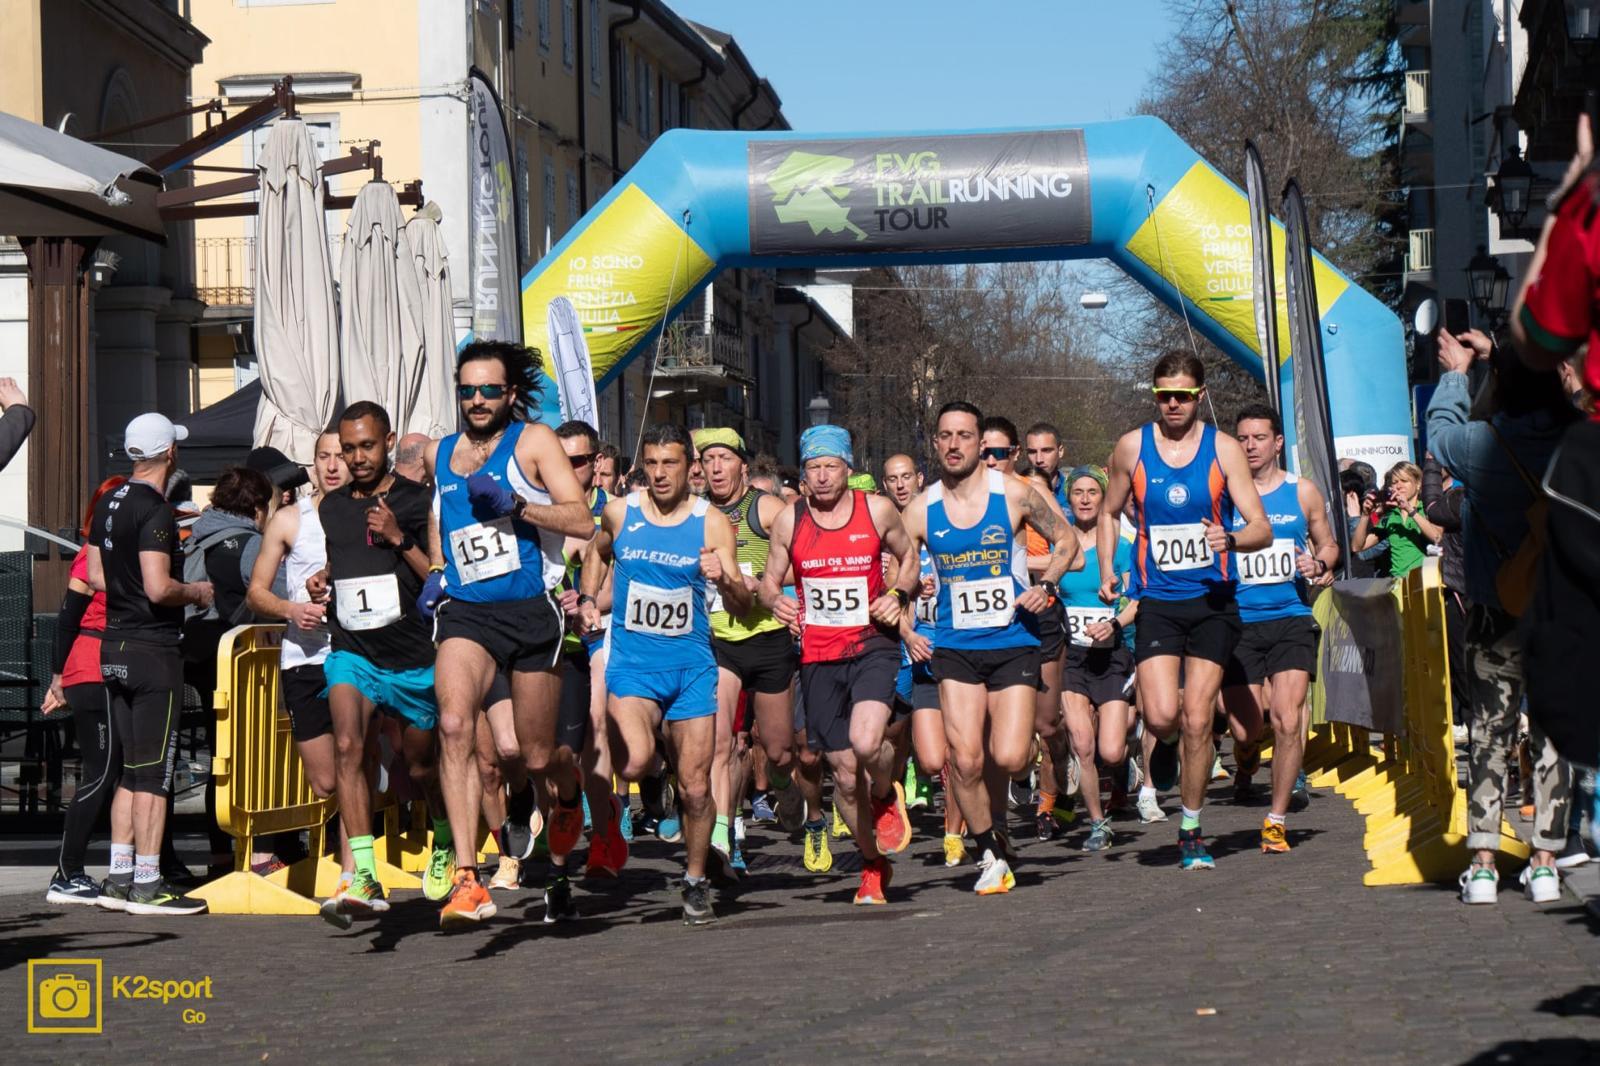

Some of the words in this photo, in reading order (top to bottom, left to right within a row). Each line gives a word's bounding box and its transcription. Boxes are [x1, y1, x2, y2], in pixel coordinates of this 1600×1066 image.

[875, 151, 941, 176] FVG
[874, 206, 949, 232] TOUR
[1202, 240, 1249, 257] FRIULI
[569, 257, 586, 271] IO
[591, 255, 644, 270] SONO
[567, 273, 614, 288] FRIULI
[577, 309, 621, 323] IULIA
[457, 529, 510, 566] 151
[940, 549, 1009, 565] Triathlon
[1156, 536, 1210, 566] 2041
[801, 559, 826, 569] QUELLI
[828, 557, 843, 567] CHE
[844, 555, 873, 566] VANNO
[1242, 551, 1292, 579] 1010
[356, 588, 373, 613] 1
[810, 588, 860, 612] 355
[958, 588, 1008, 614] 158
[631, 598, 689, 630] 1029
